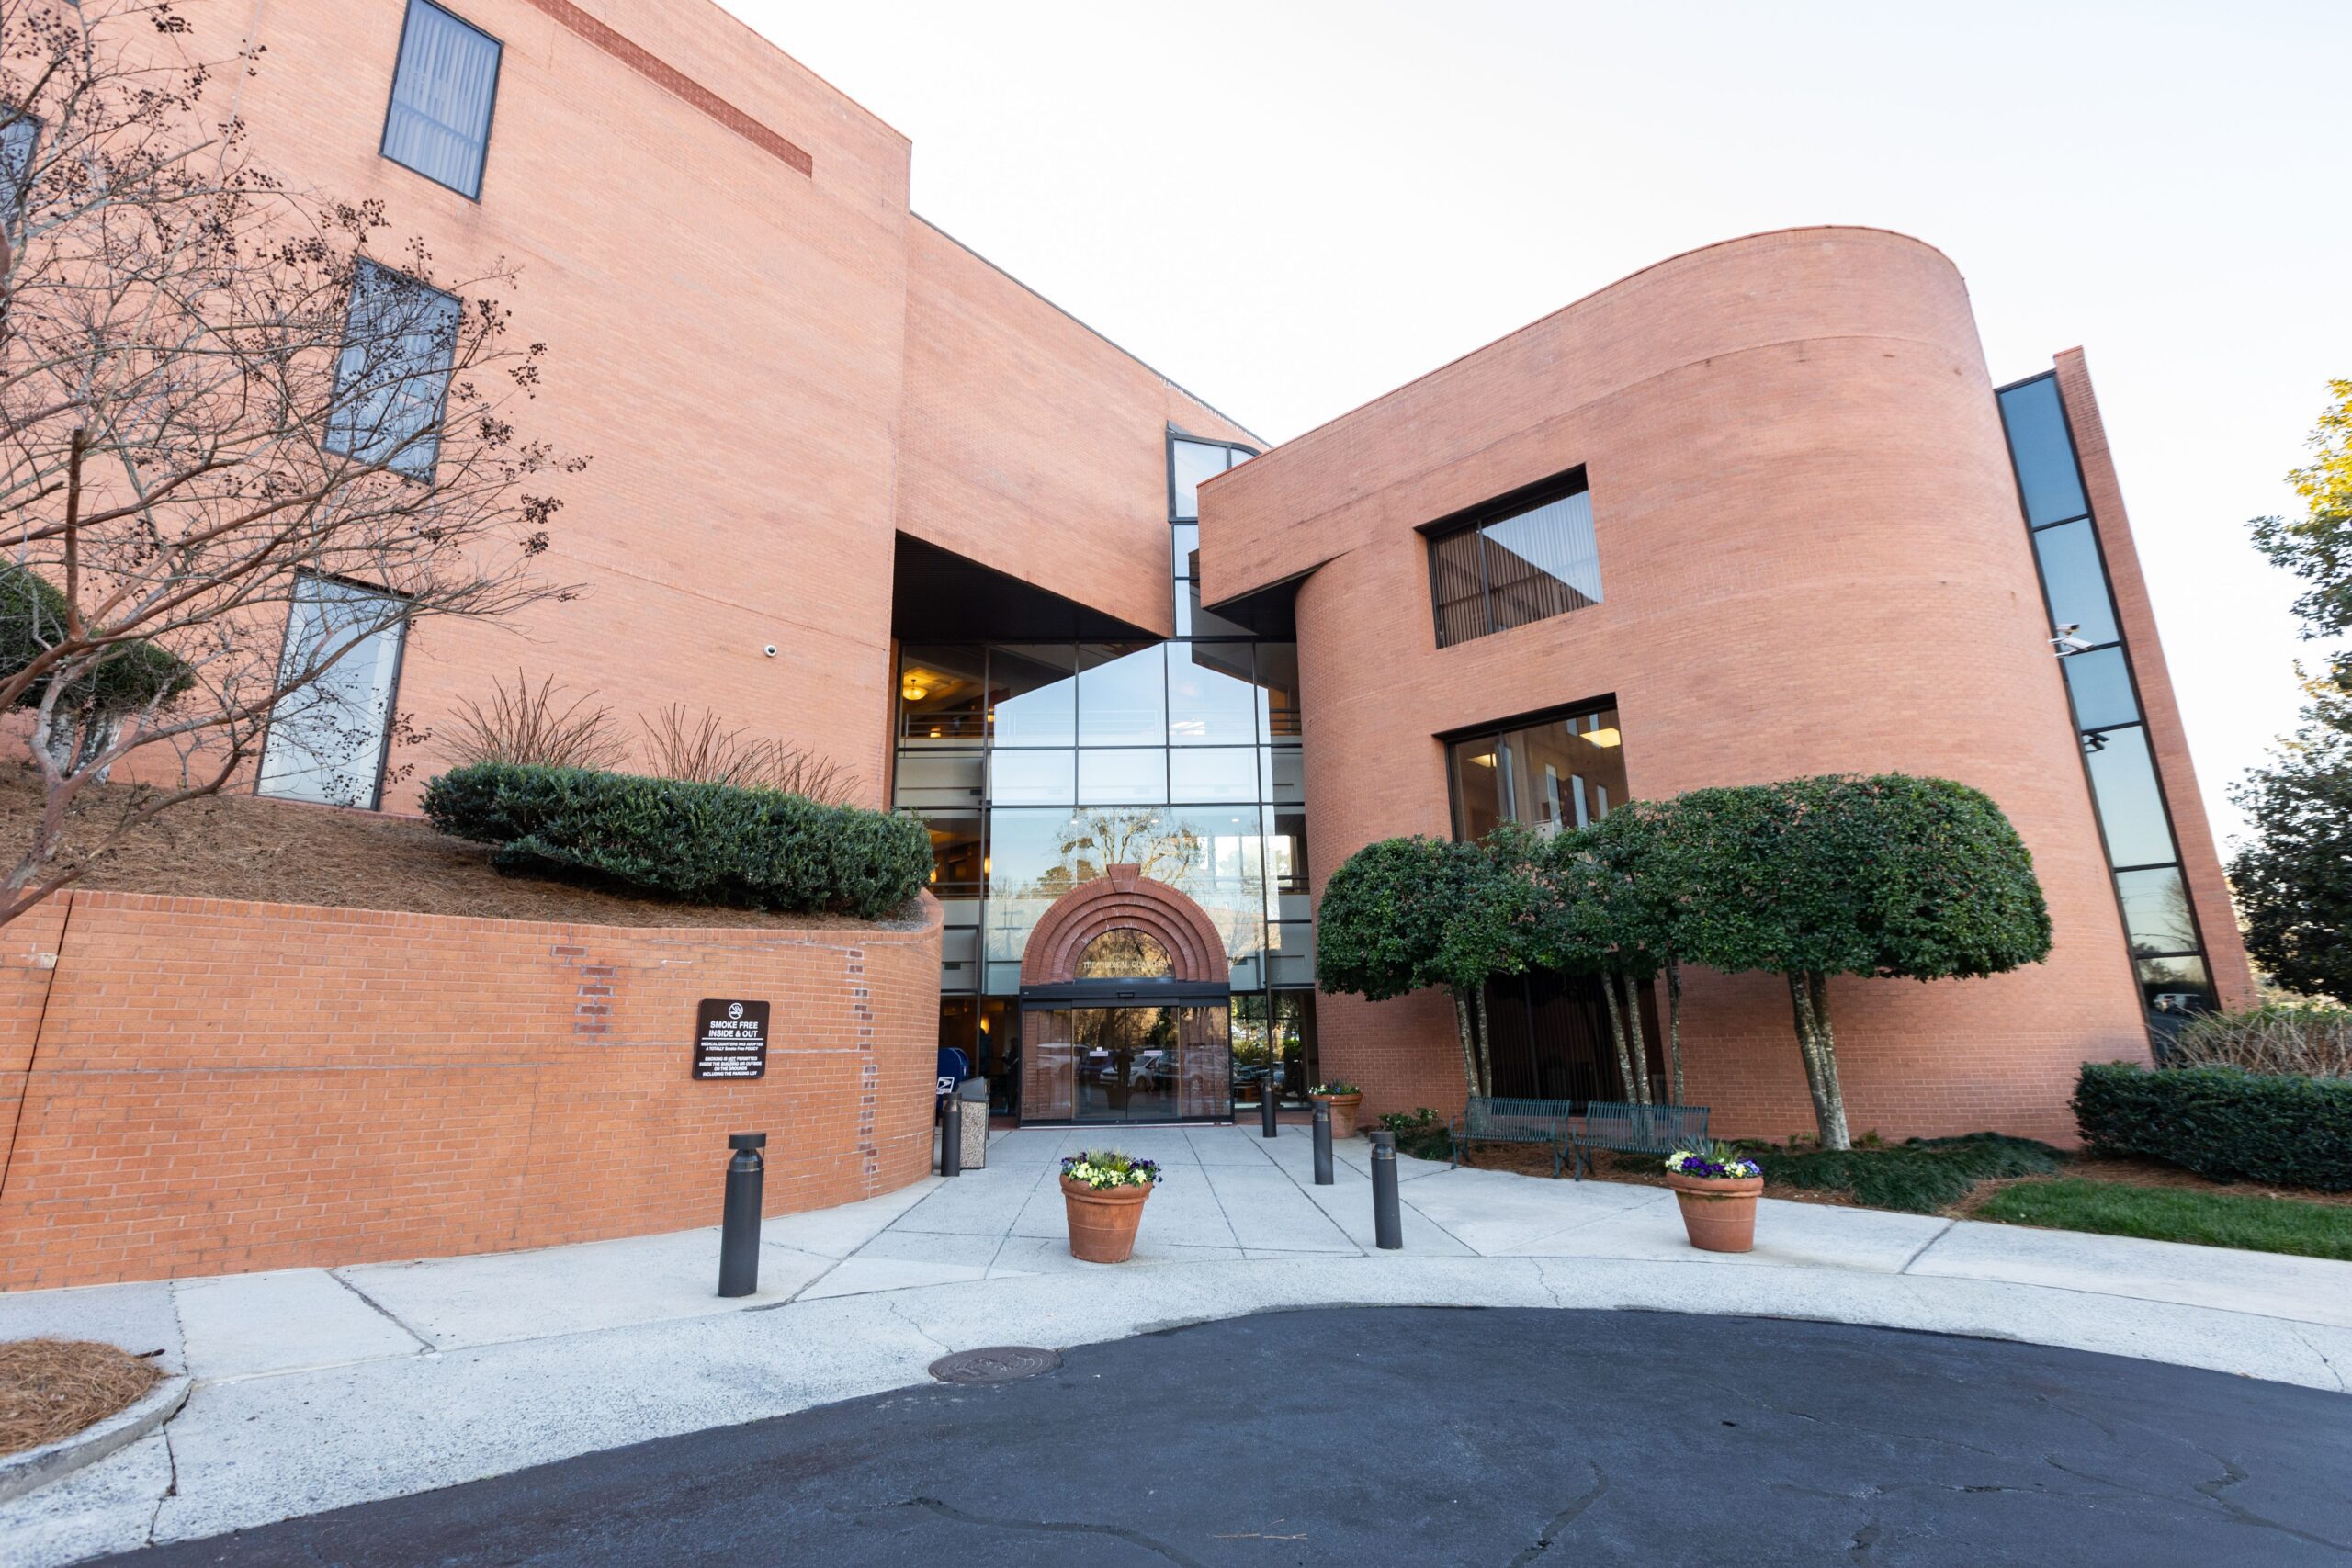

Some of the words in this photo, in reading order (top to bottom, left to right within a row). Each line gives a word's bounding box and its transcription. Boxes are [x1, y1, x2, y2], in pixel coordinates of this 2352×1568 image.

[1083, 961, 1095, 969] THE
[710, 1021, 738, 1029] SMOKE
[739, 1021, 759, 1030] FREE
[735, 1030, 741, 1038] &
[742, 1030, 759, 1038] OUT
